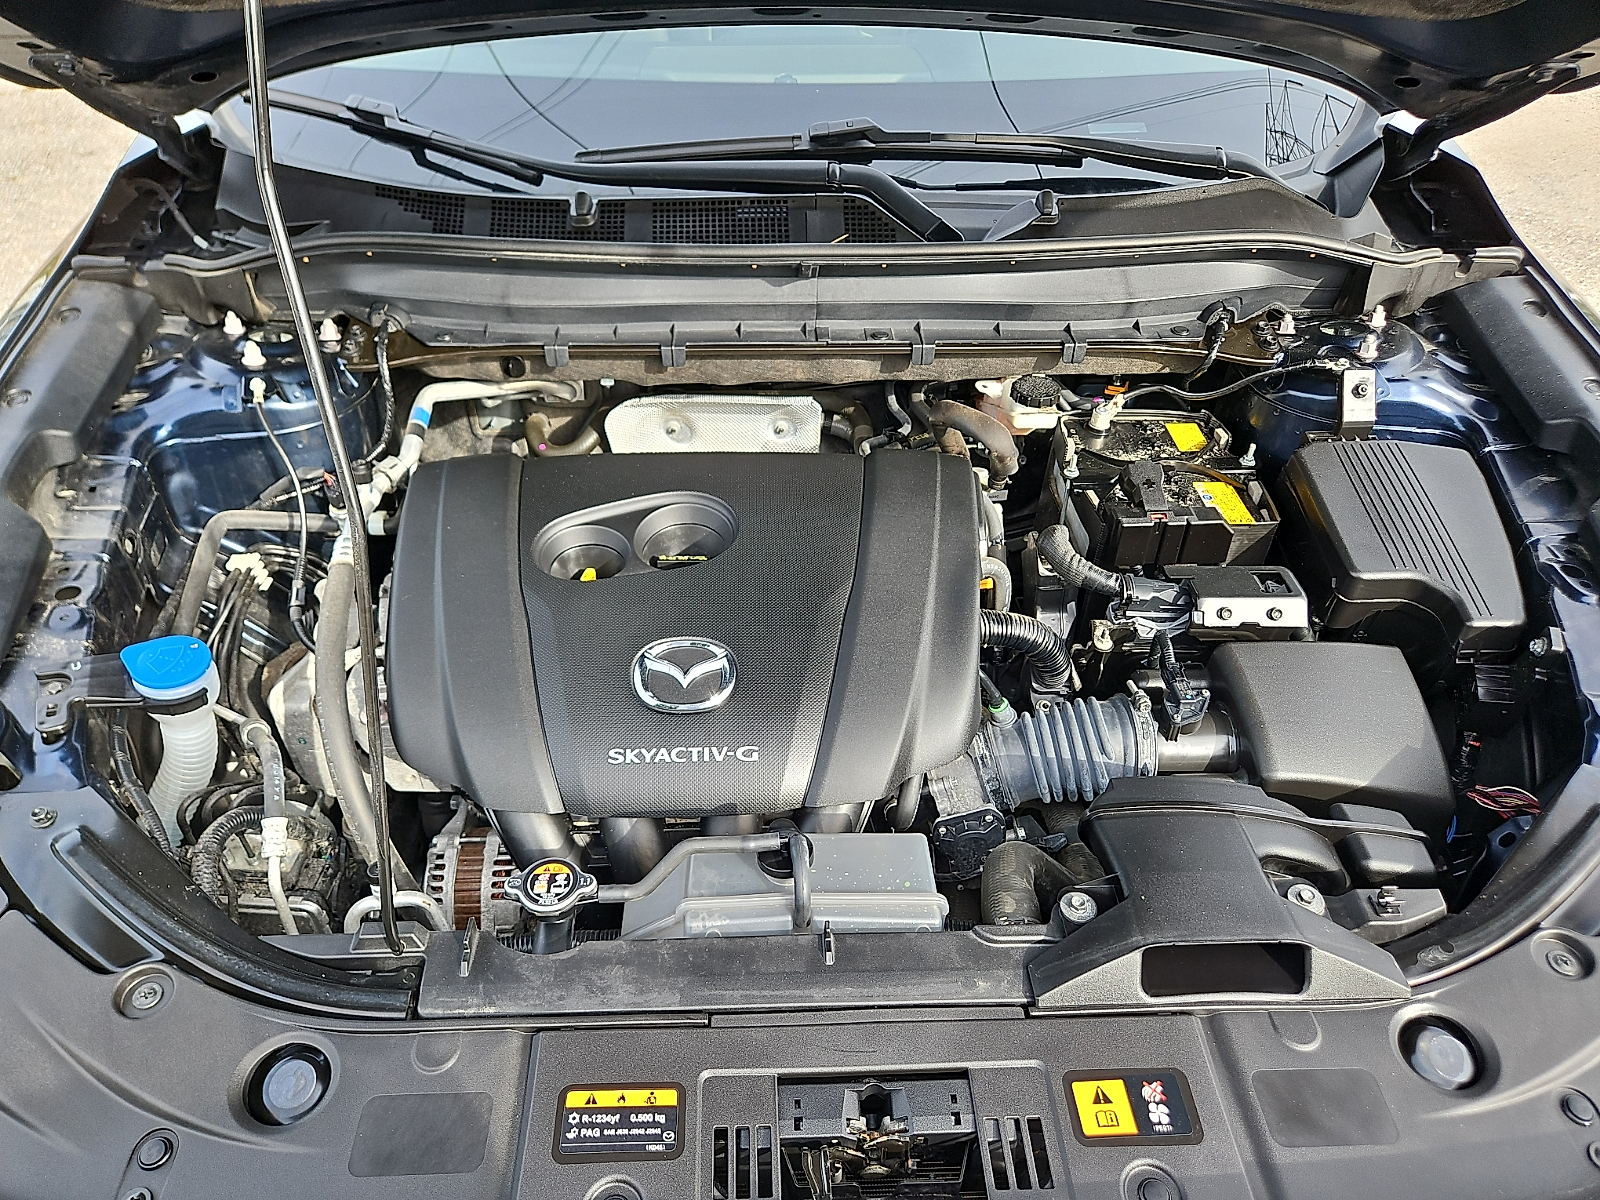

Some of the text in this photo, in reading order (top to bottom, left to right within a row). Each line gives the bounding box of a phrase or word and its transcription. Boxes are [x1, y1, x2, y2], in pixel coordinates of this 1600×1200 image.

[607, 745, 759, 765] SKYACTIV-G
[581, 1113, 666, 1125] R-1234yf 0.500 kg
[580, 1127, 600, 1139] PAG
